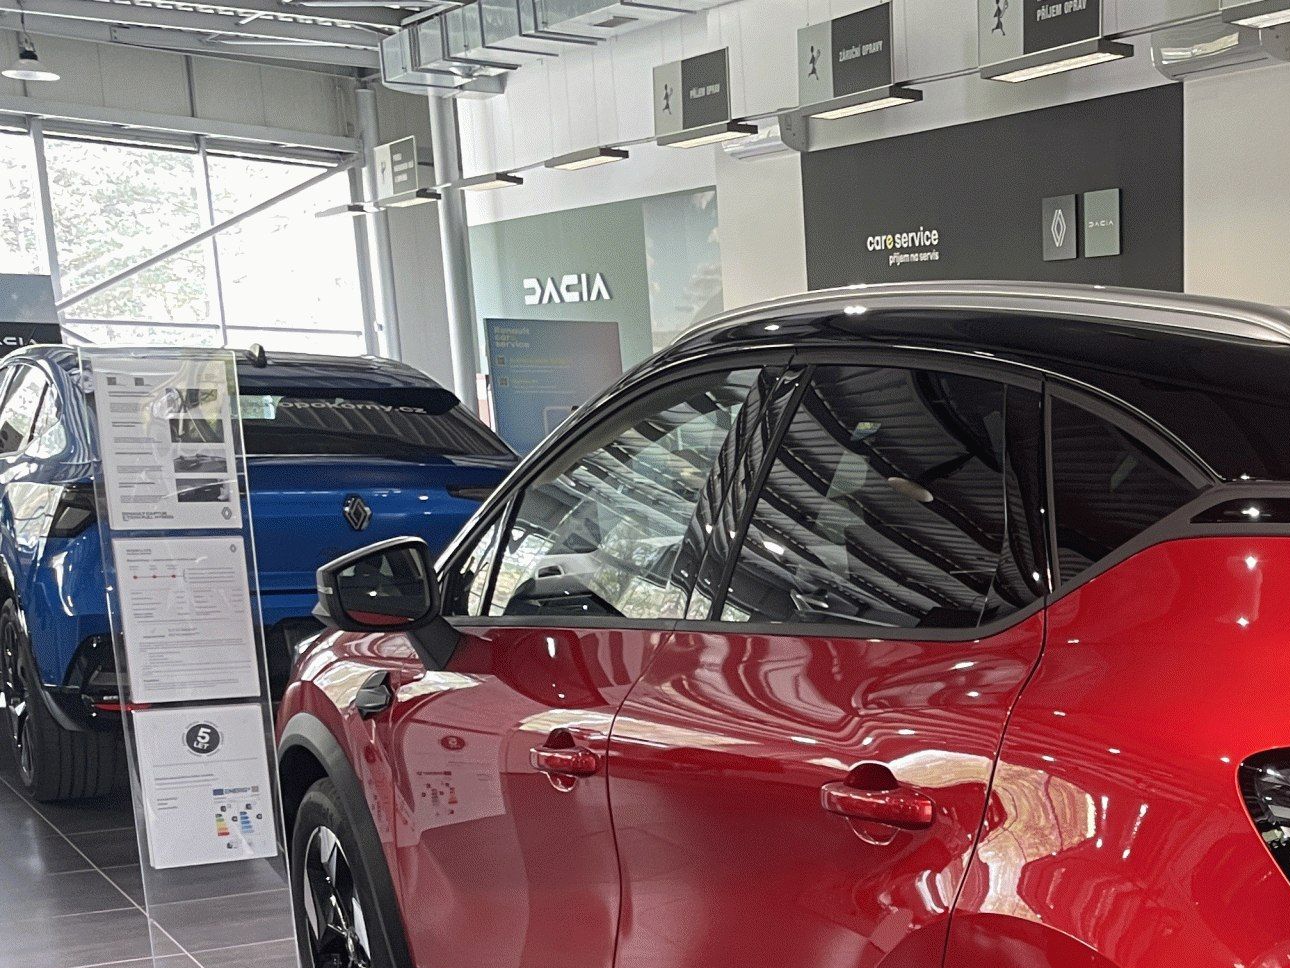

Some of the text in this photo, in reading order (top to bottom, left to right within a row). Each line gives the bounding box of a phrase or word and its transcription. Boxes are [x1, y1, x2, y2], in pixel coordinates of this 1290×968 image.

[1088, 220, 1114, 228] DACIA
[867, 226, 939, 251] care service
[919, 249, 939, 262] servis
[523, 272, 611, 305] DACIA
[197, 727, 211, 743] 5
[193, 741, 210, 750] LET
